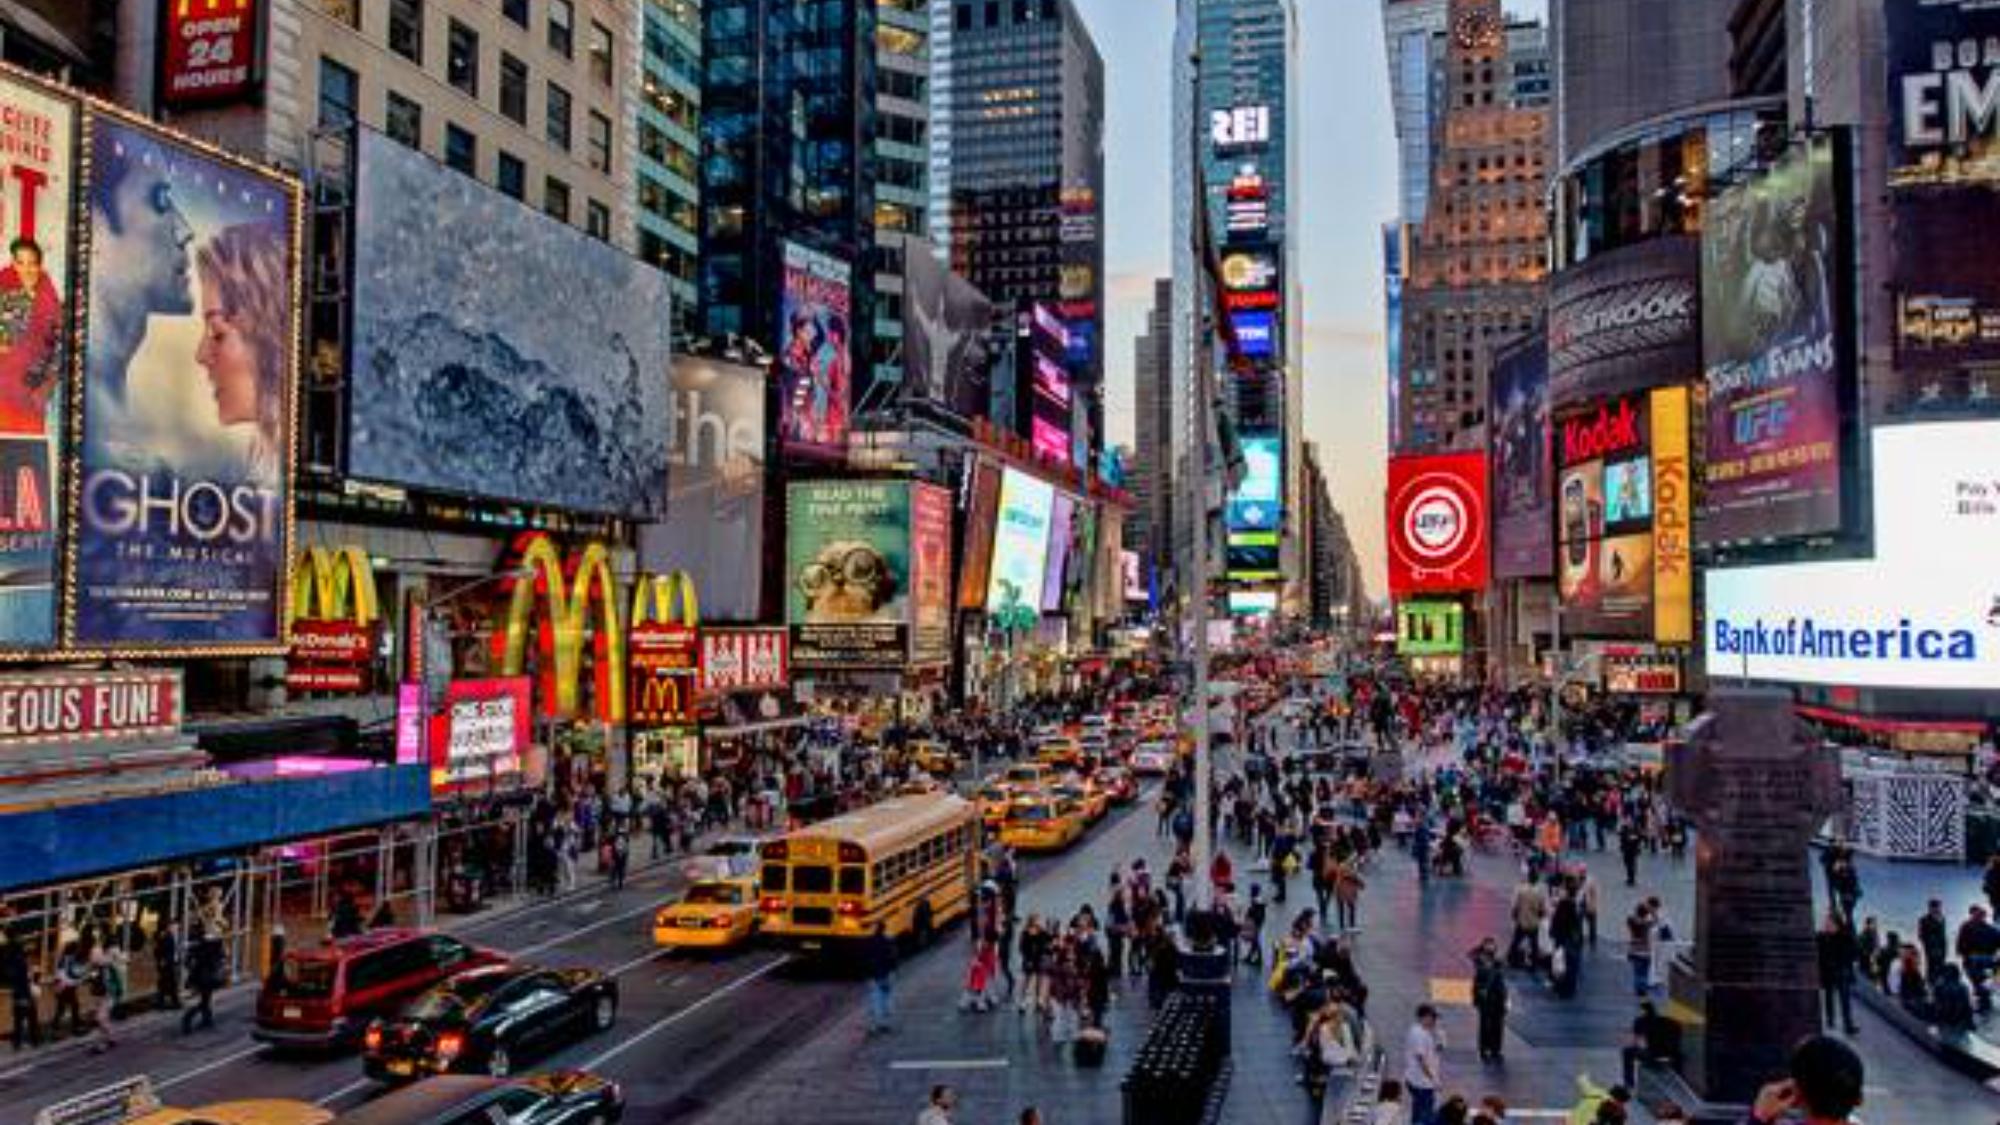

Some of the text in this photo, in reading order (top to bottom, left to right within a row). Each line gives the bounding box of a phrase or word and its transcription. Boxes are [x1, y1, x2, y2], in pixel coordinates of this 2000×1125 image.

[181, 16, 240, 39] OPEN
[187, 35, 233, 67] 24
[174, 65, 247, 91] HOURS
[1903, 70, 2000, 145] EM
[1565, 399, 1639, 465] Kodak
[86, 469, 277, 542] GHOST
[1656, 456, 1685, 573] Kodak
[115, 540, 253, 564] THE MUSICAL
[1715, 617, 1977, 660] Bank of America
[1, 681, 161, 734] EOUS FUN!
